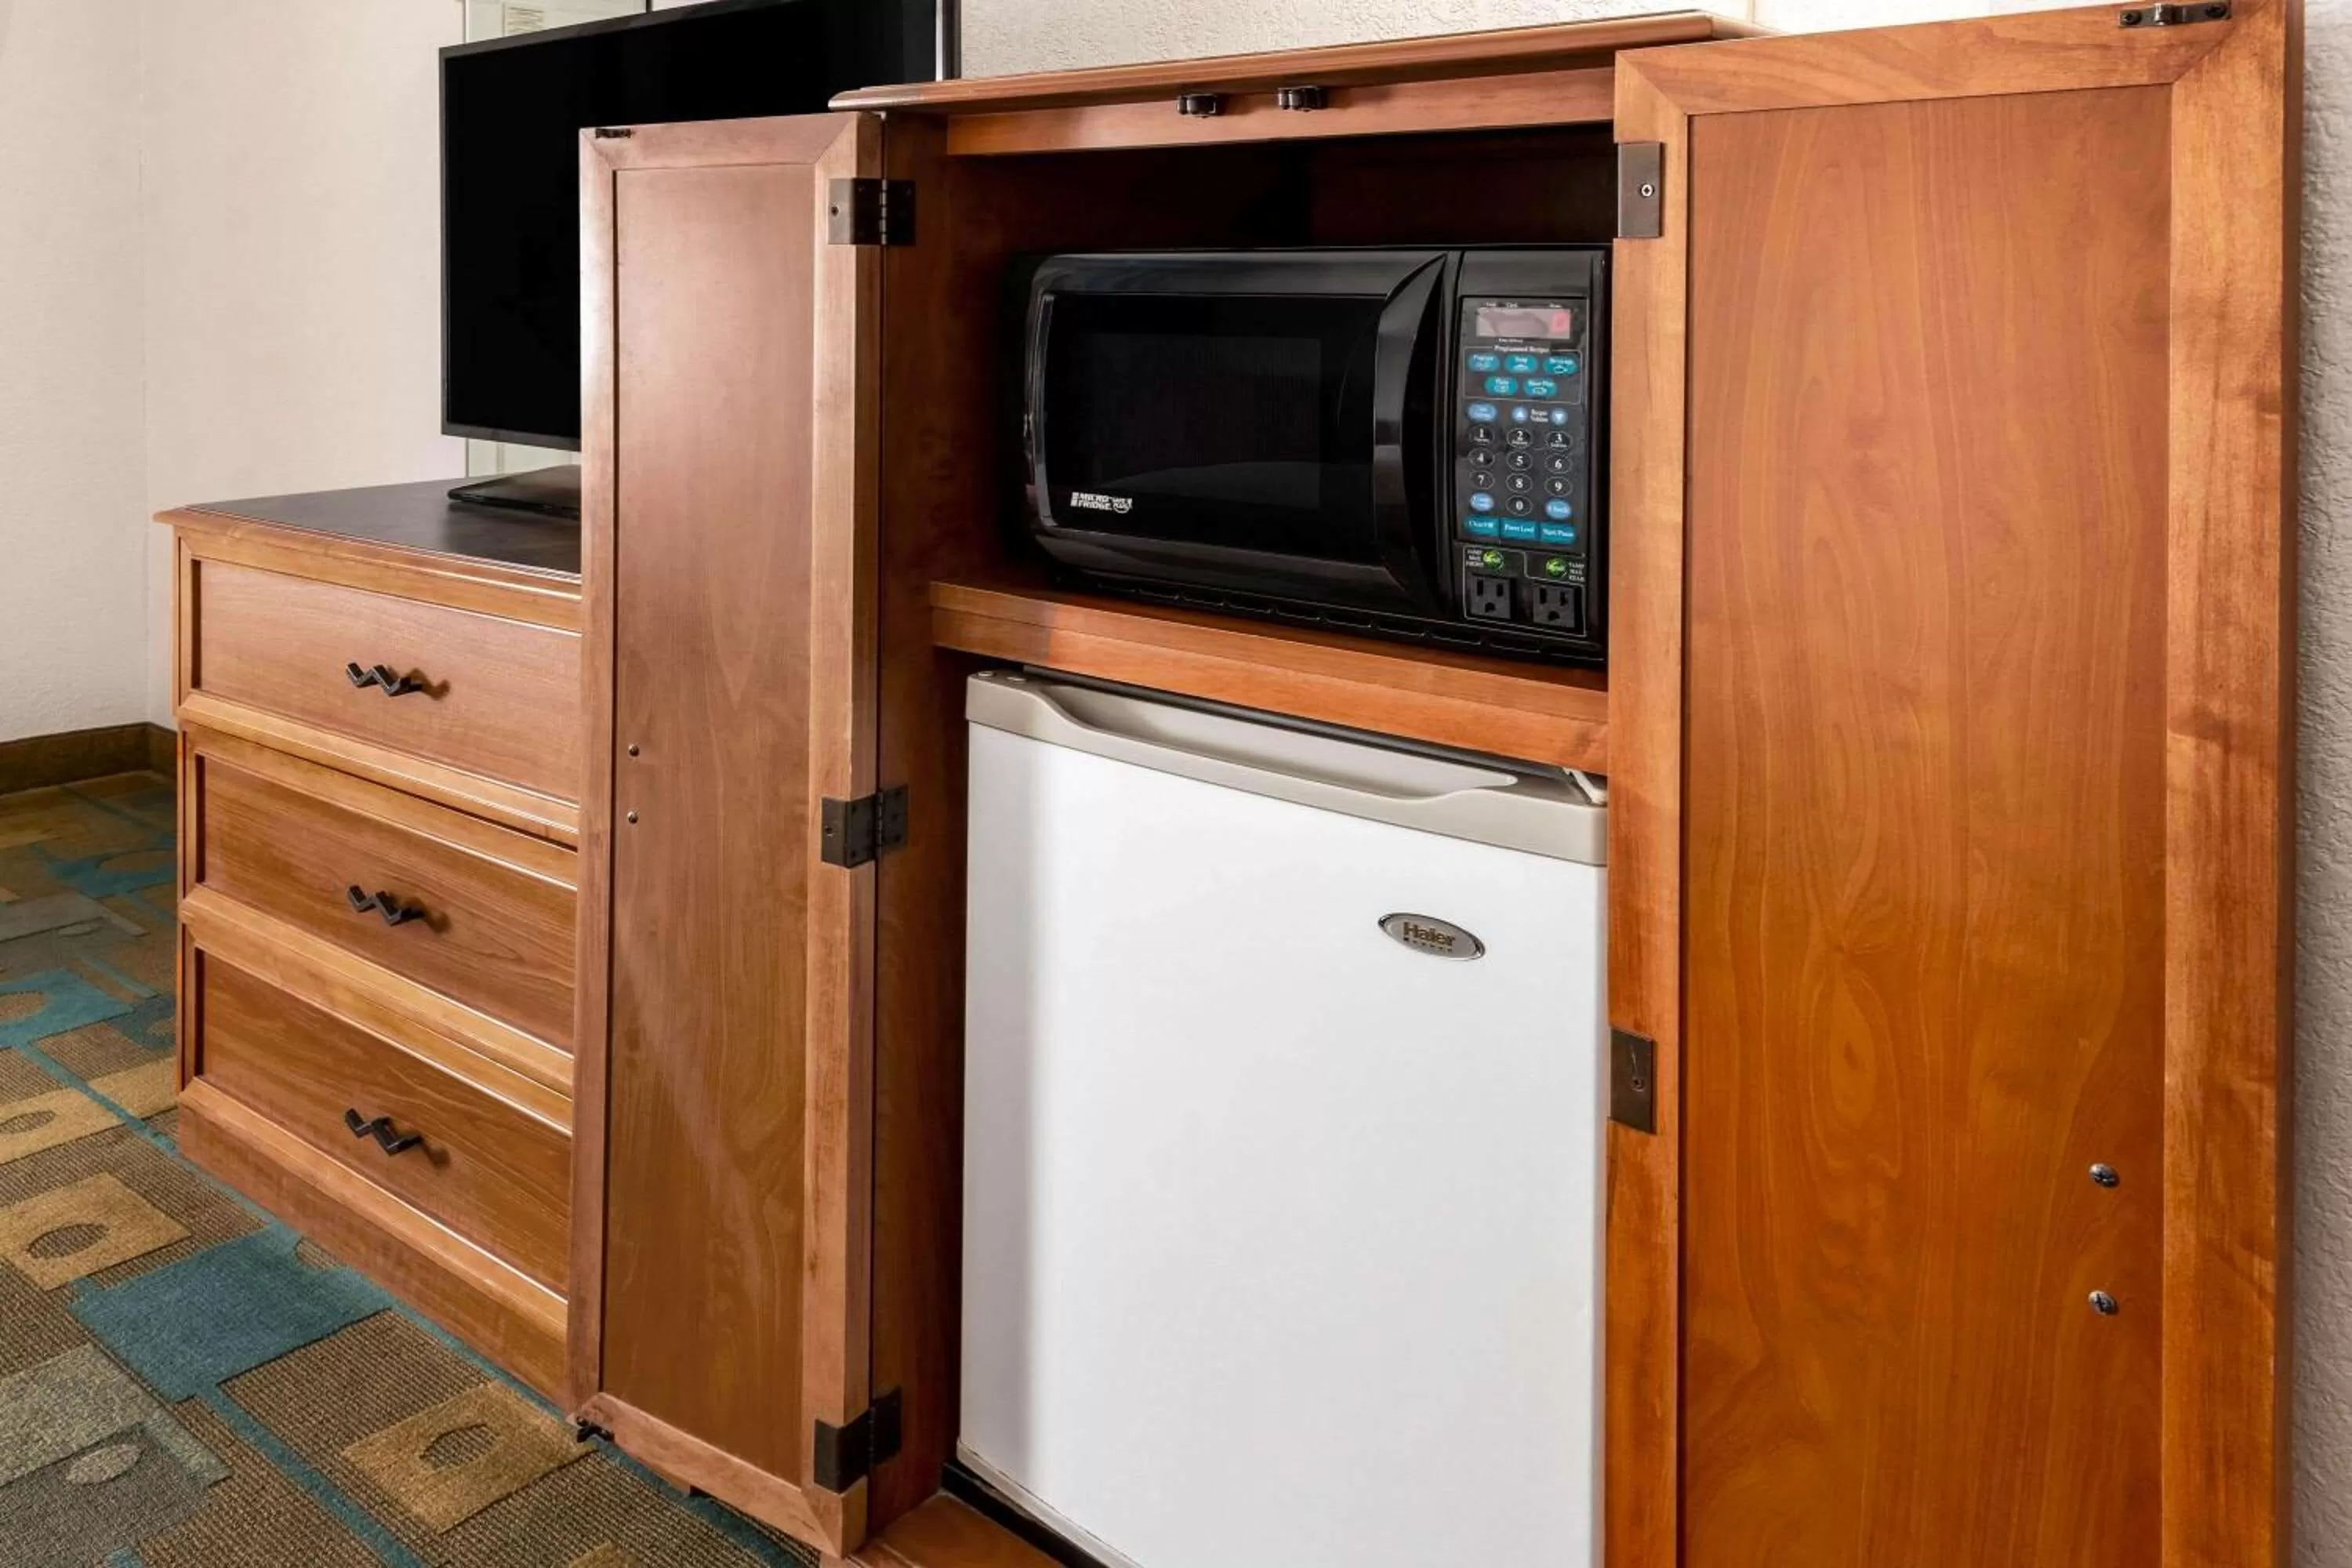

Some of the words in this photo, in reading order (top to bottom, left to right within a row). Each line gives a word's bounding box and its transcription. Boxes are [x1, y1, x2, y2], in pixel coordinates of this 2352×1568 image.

[1479, 428, 1484, 438] 1
[1517, 430, 1523, 441] 2
[1556, 434, 1563, 443] 3
[1477, 453, 1484, 463] 4
[1516, 456, 1523, 466] 5
[1555, 459, 1563, 470] 6
[1478, 474, 1484, 485] 7
[1515, 478, 1523, 488] 8
[1555, 481, 1563, 492] 9
[1515, 500, 1523, 510] 0
[1403, 922, 1456, 946] Haier
